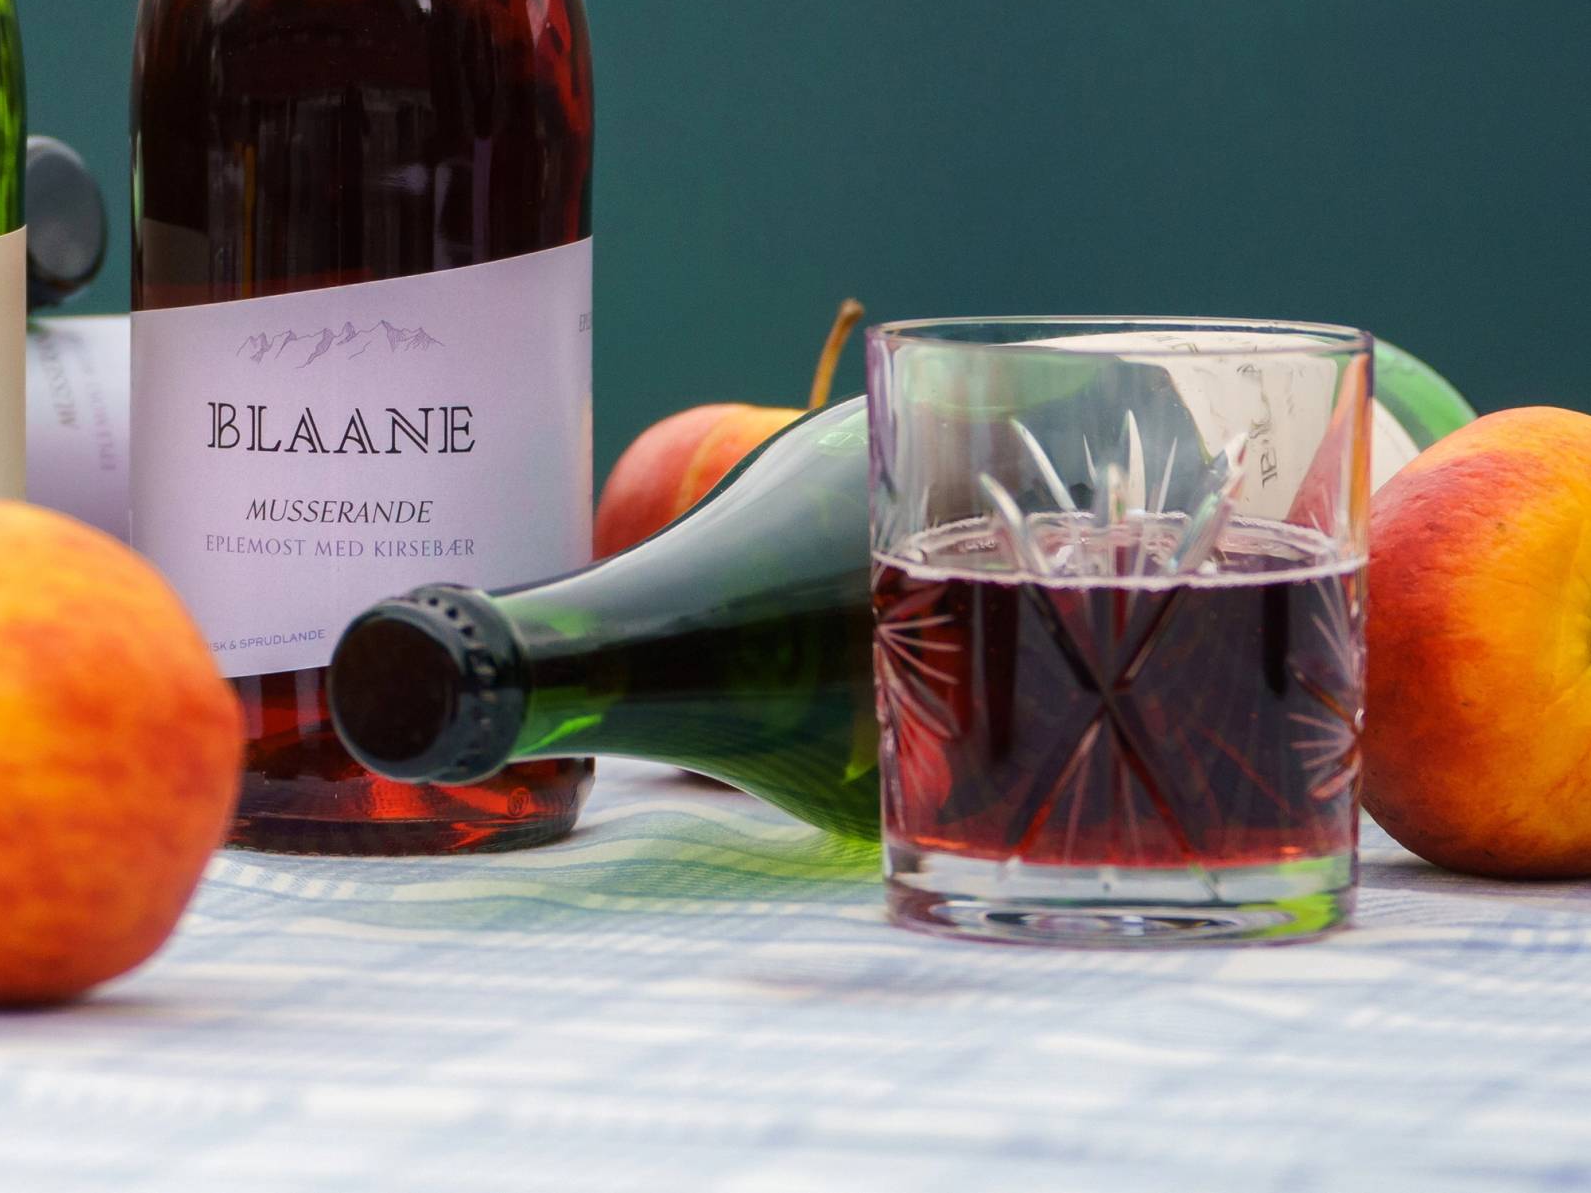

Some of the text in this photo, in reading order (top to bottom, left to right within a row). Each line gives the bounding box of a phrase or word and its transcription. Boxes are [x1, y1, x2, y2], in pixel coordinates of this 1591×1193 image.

[207, 402, 475, 454] BLAANE
[246, 498, 433, 523] MUSSERANDE
[206, 535, 474, 557] EPLEMOST MED KIRSEBÆR
[229, 640, 237, 650] &
[239, 628, 327, 649] SPRUDLANDE
